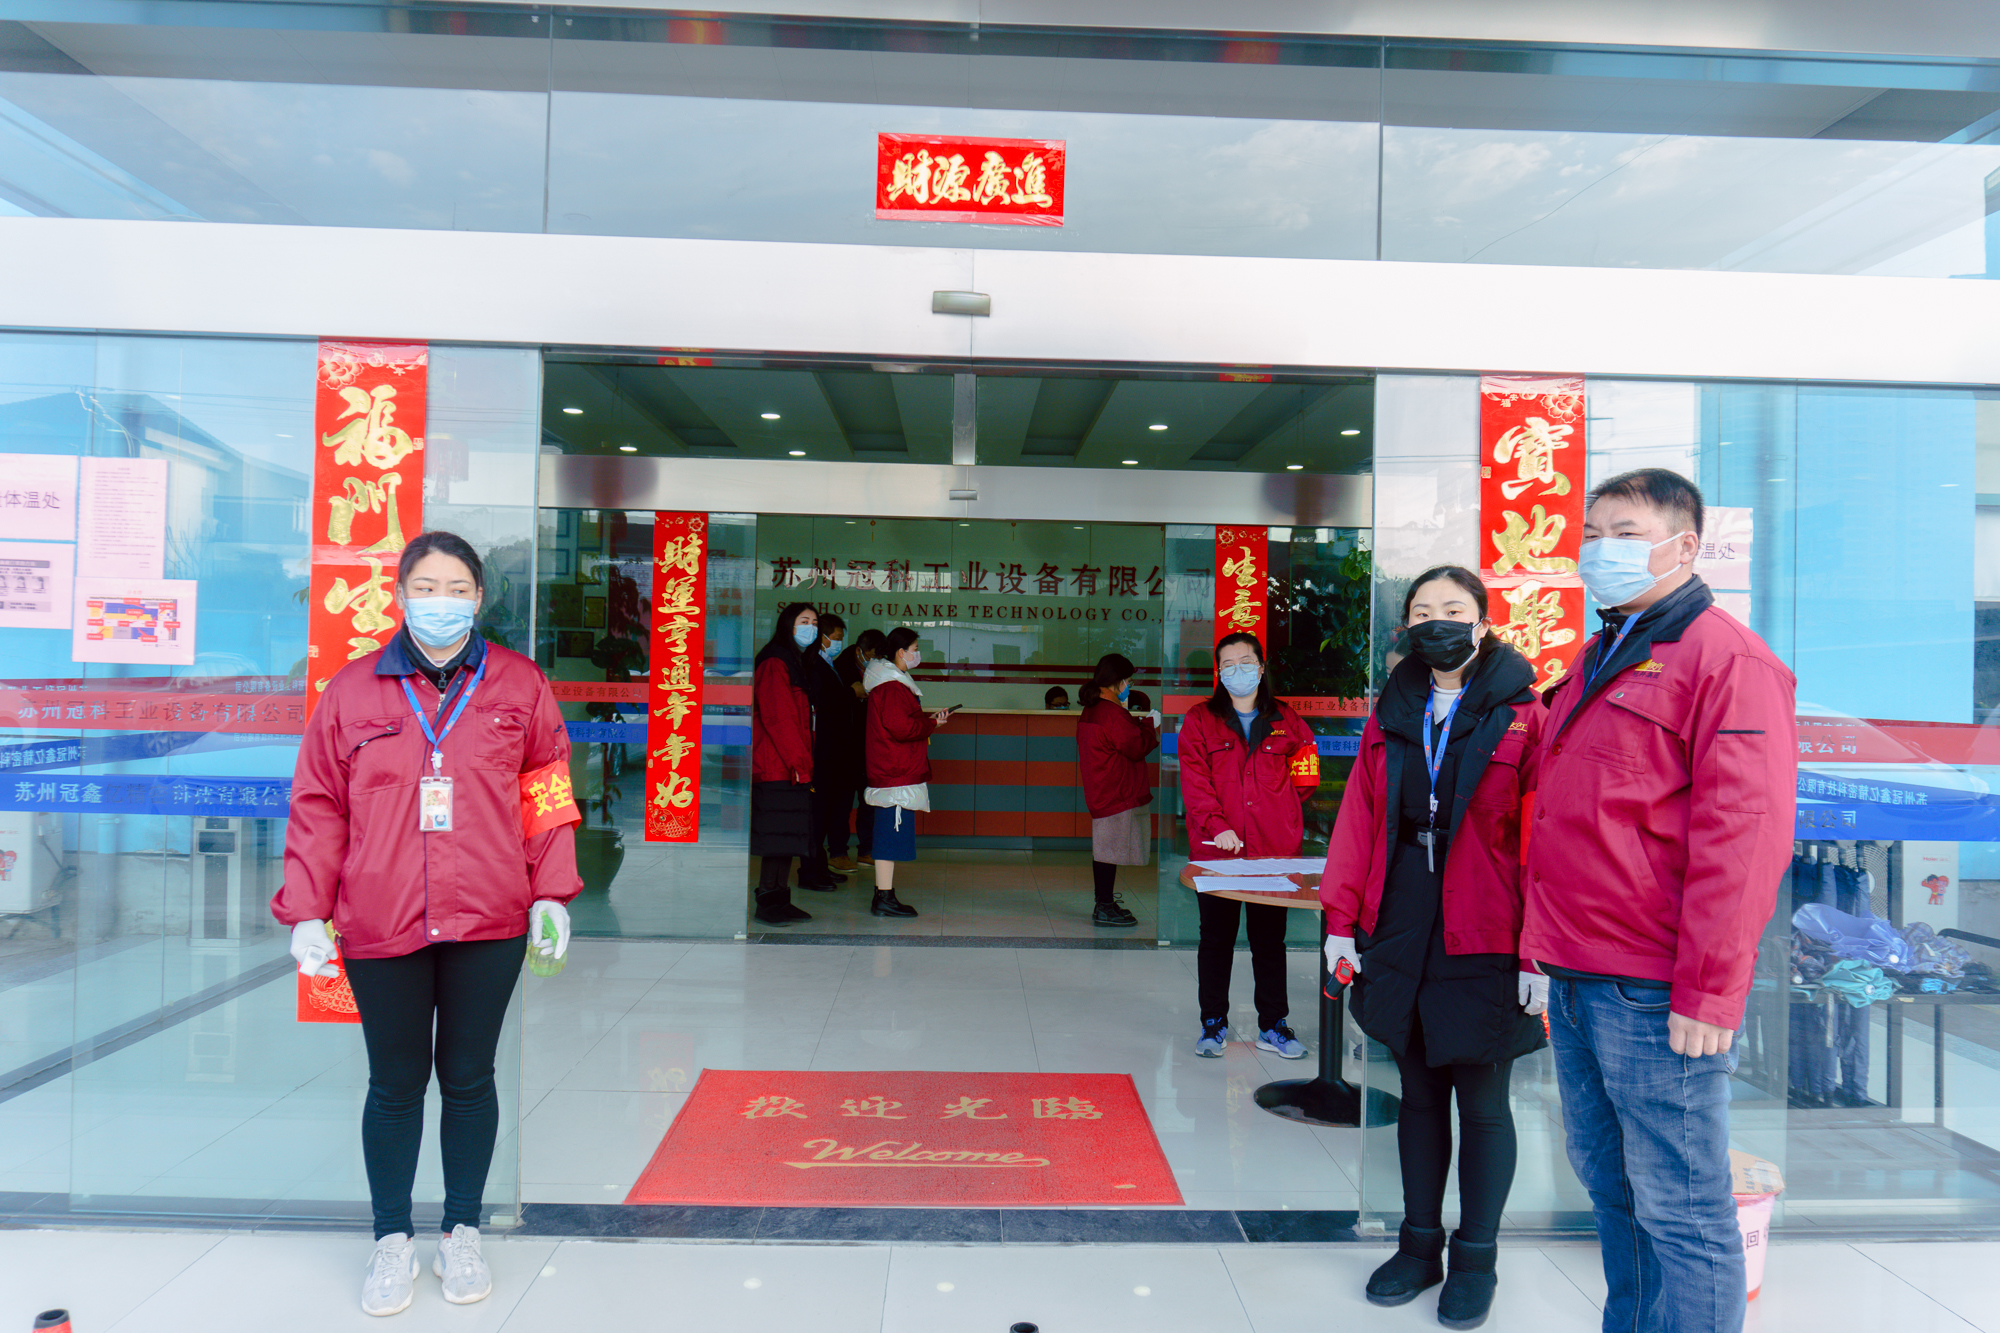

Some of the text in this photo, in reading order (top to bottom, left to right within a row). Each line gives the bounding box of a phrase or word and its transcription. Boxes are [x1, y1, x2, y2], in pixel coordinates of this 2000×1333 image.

[0, 488, 60, 510] 体温处
[770, 556, 1211, 598] 苏州冠科工业设备有限公司
[1218, 545, 1263, 637] 生意
[776, 601, 861, 616] SHOU
[871, 603, 959, 618] GUANKE
[968, 605, 1112, 621] TECHNOLOGY
[17, 698, 305, 724] 苏州冠科工业设备有限公司
[528, 773, 573, 817] 安全
[783, 1139, 1051, 1168] Welcome
